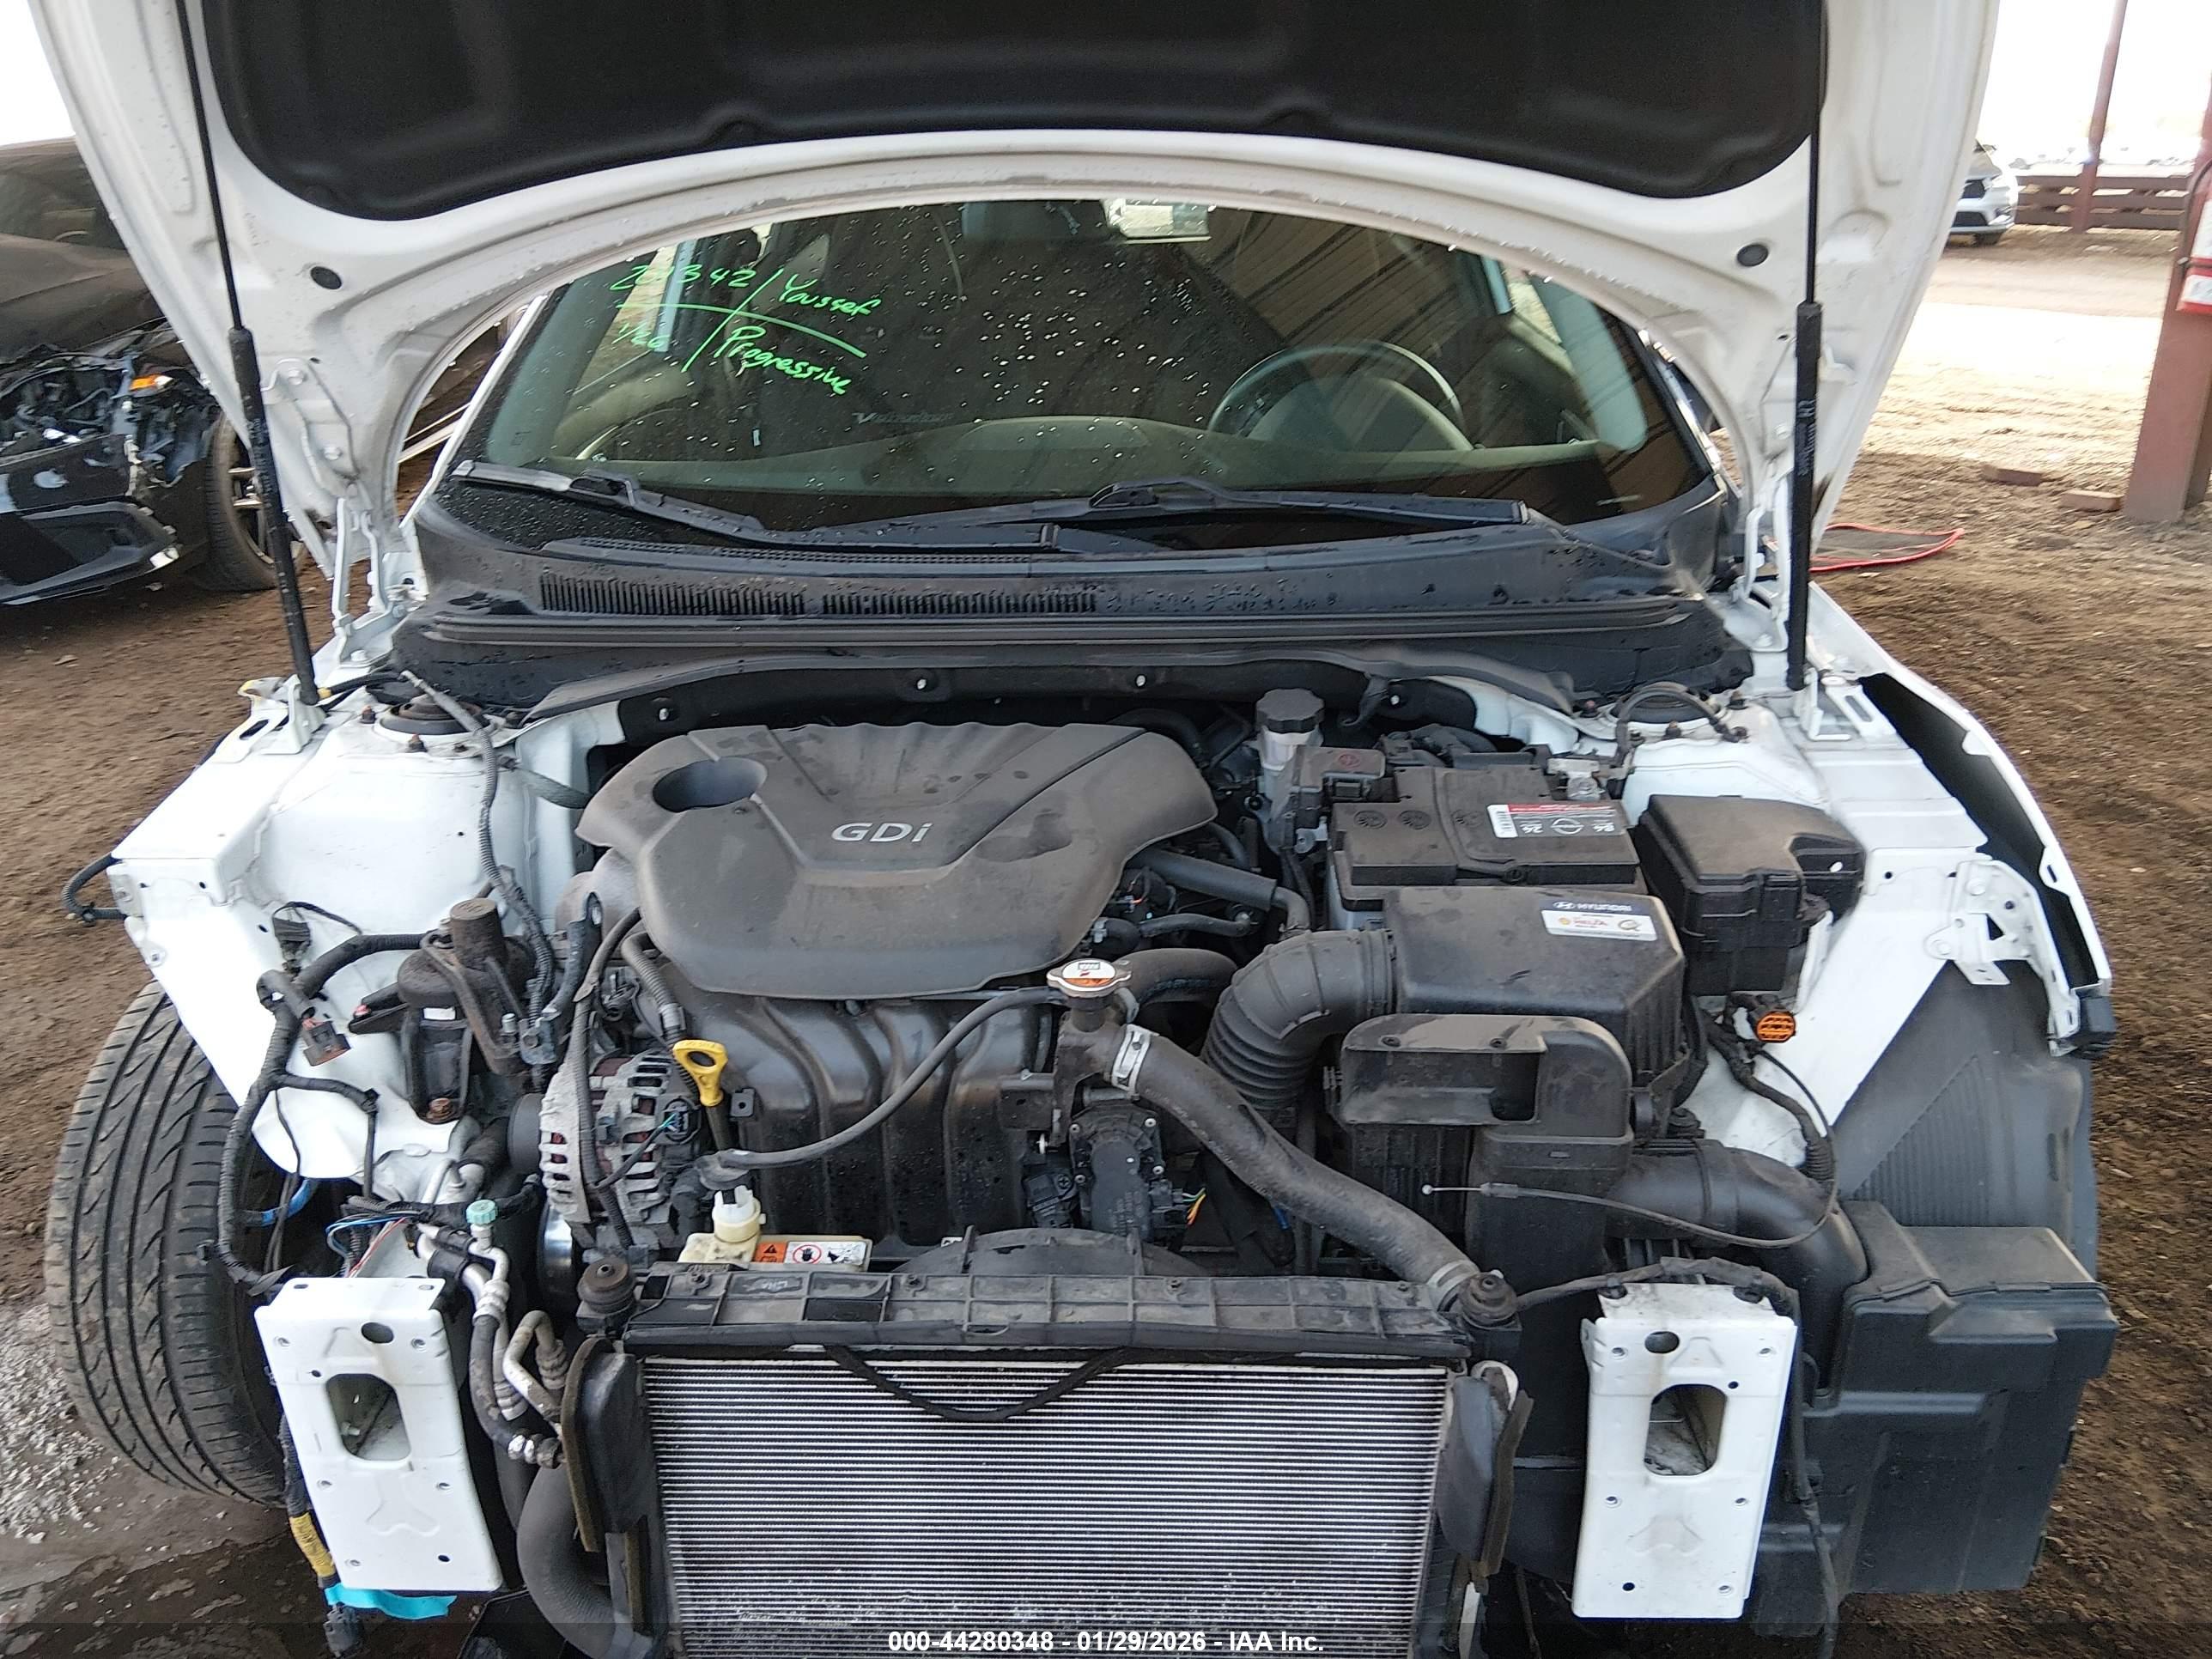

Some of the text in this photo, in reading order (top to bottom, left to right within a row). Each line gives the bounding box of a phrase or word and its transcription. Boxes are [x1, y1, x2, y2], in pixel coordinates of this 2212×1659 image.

[779, 274, 880, 315] Youssef
[714, 326, 854, 395] Progressive
[831, 822, 933, 842] GDi
